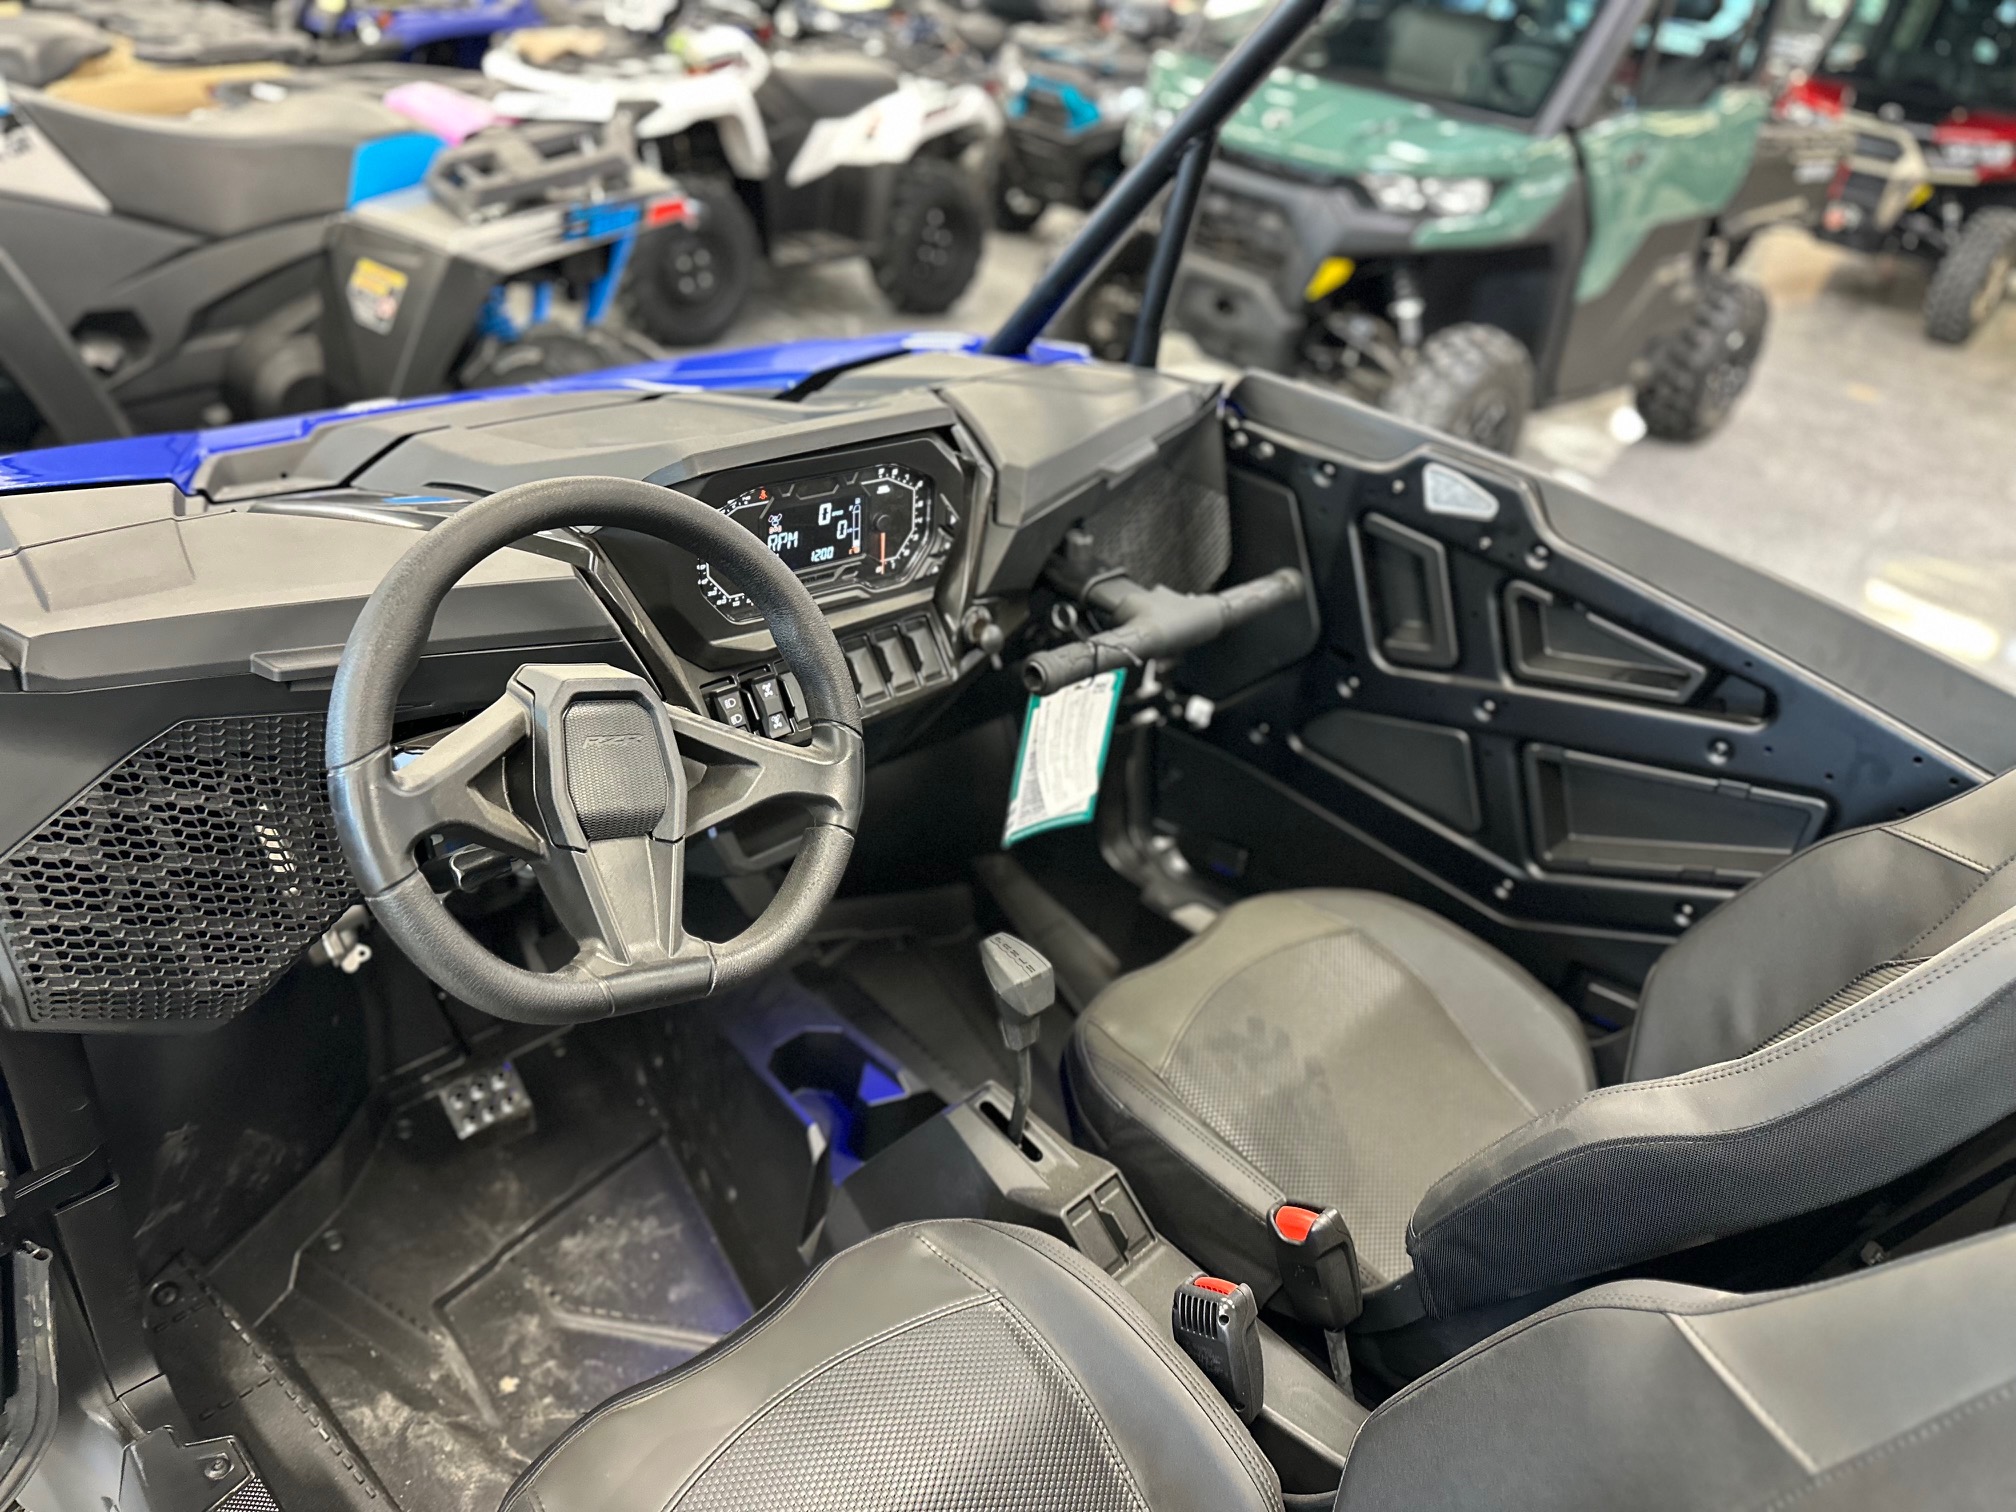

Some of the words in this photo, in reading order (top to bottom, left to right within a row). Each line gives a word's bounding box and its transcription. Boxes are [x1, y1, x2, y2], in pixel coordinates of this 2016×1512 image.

[818, 502, 832, 526] 0
[836, 519, 848, 540] 0
[767, 531, 799, 551] RPM
[810, 546, 835, 563] 1200
[582, 733, 643, 749] RZR
